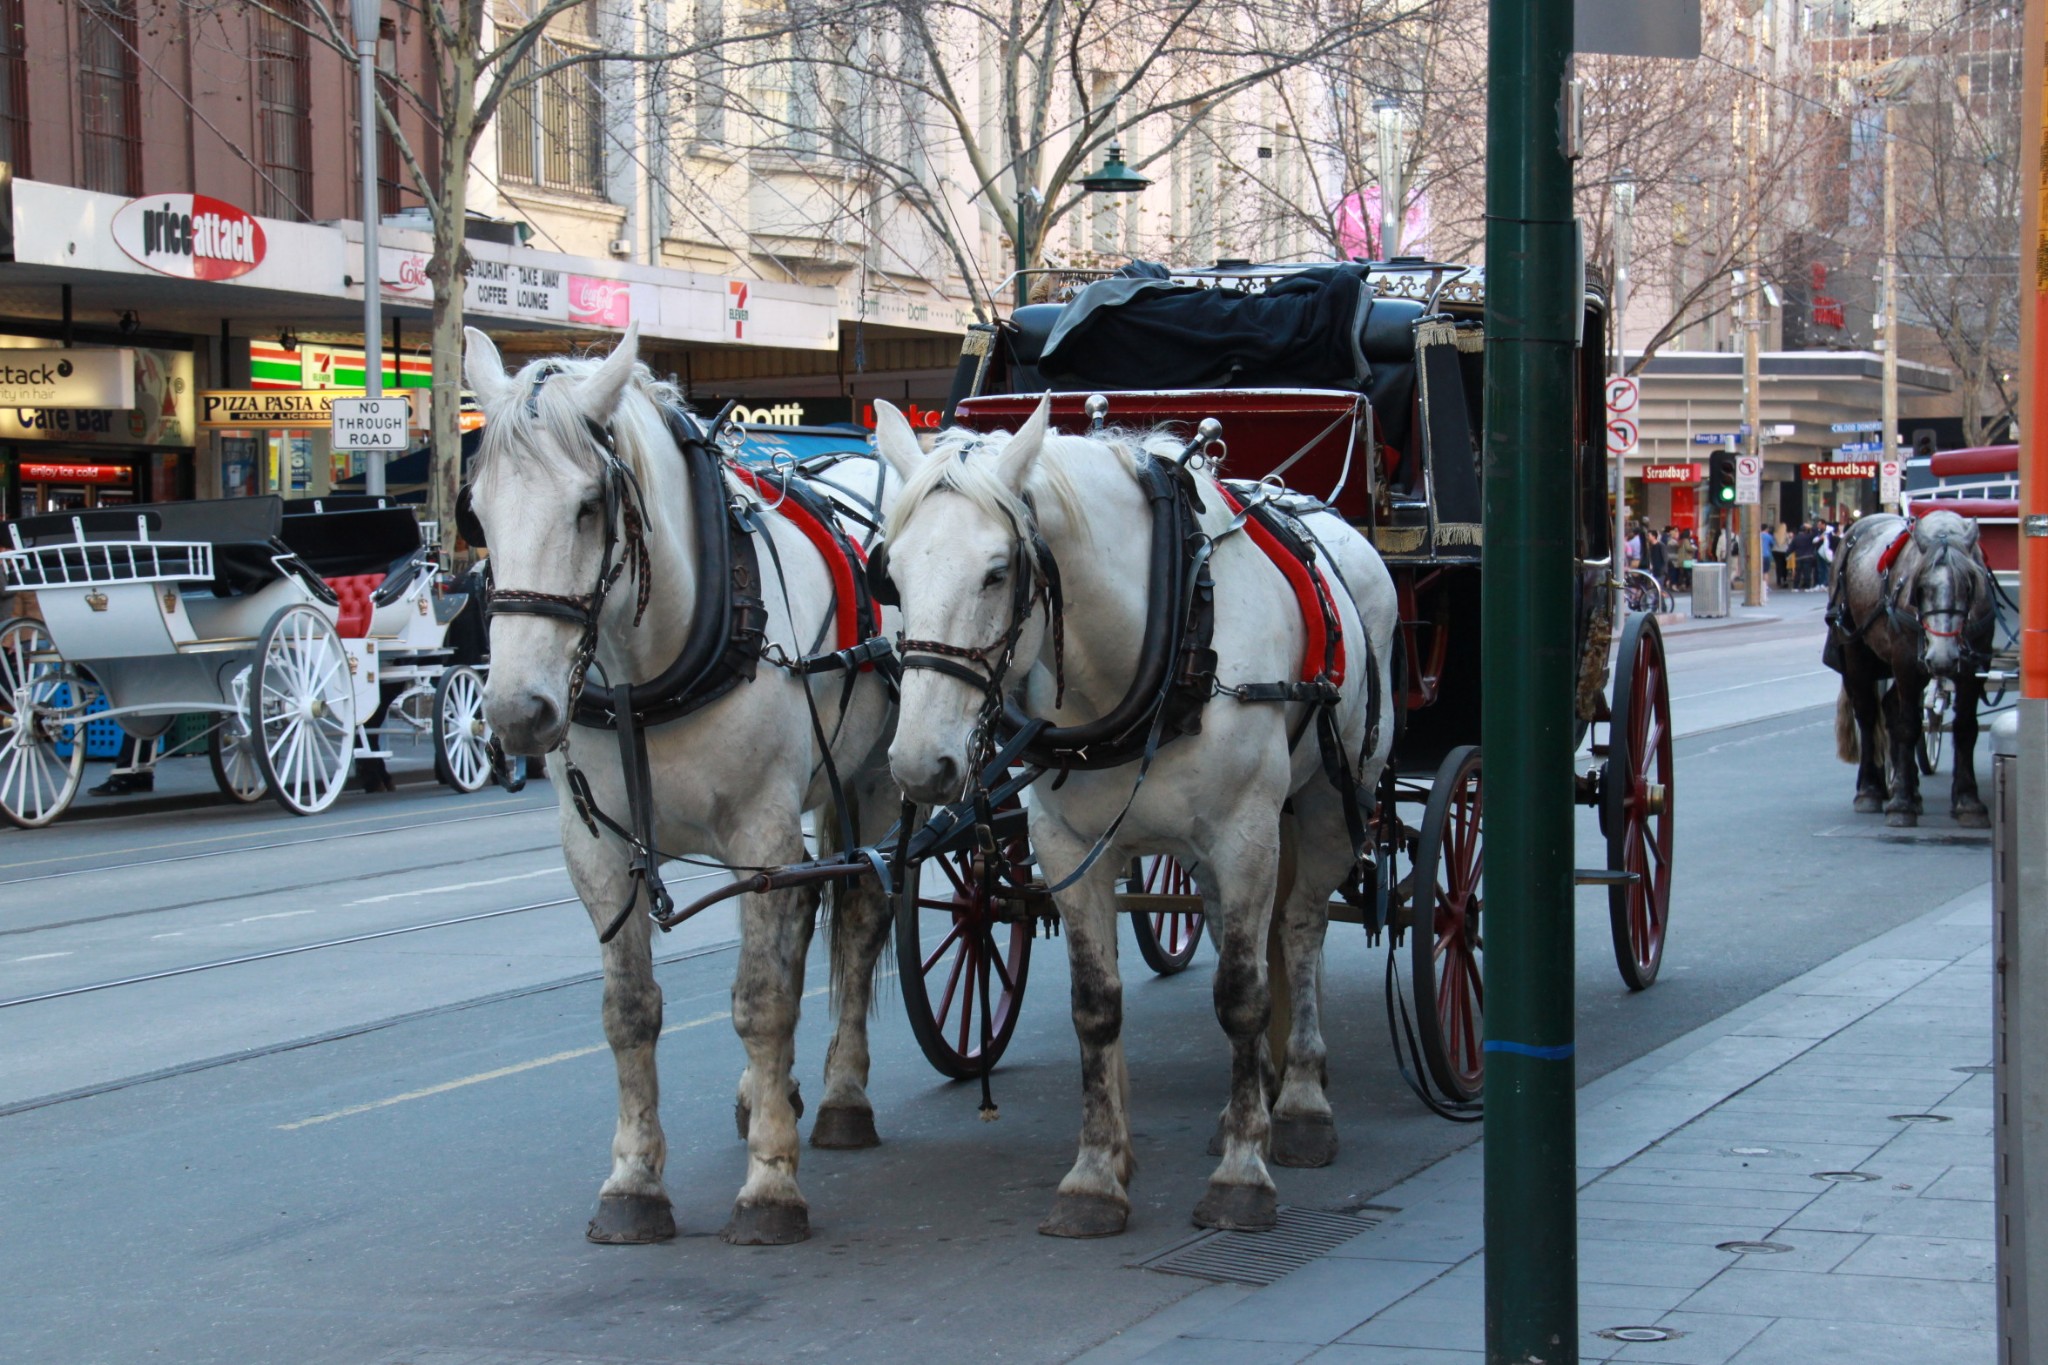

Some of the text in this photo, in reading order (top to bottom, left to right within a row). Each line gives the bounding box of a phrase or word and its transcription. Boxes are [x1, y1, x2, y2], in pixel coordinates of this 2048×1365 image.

[143, 203, 254, 263] price attack
[400, 261, 428, 286] Coke
[465, 260, 560, 289] STAURANT TAKE AWAY
[477, 285, 548, 310] COFFEE LOUNGE
[203, 396, 257, 422] PIZZA
[265, 396, 314, 411] PASTA
[319, 396, 332, 411] &
[238, 412, 332, 420] FULLY LICENSE
[359, 402, 379, 414] NO
[730, 402, 804, 427] Dotti
[76, 408, 113, 432] Bar
[338, 418, 402, 429] THROUGH
[349, 434, 392, 446] ROAD
[30, 466, 98, 478] enjoy ice cold
[1646, 466, 1690, 481] Strandbags
[1808, 463, 1876, 478] Strandbag
